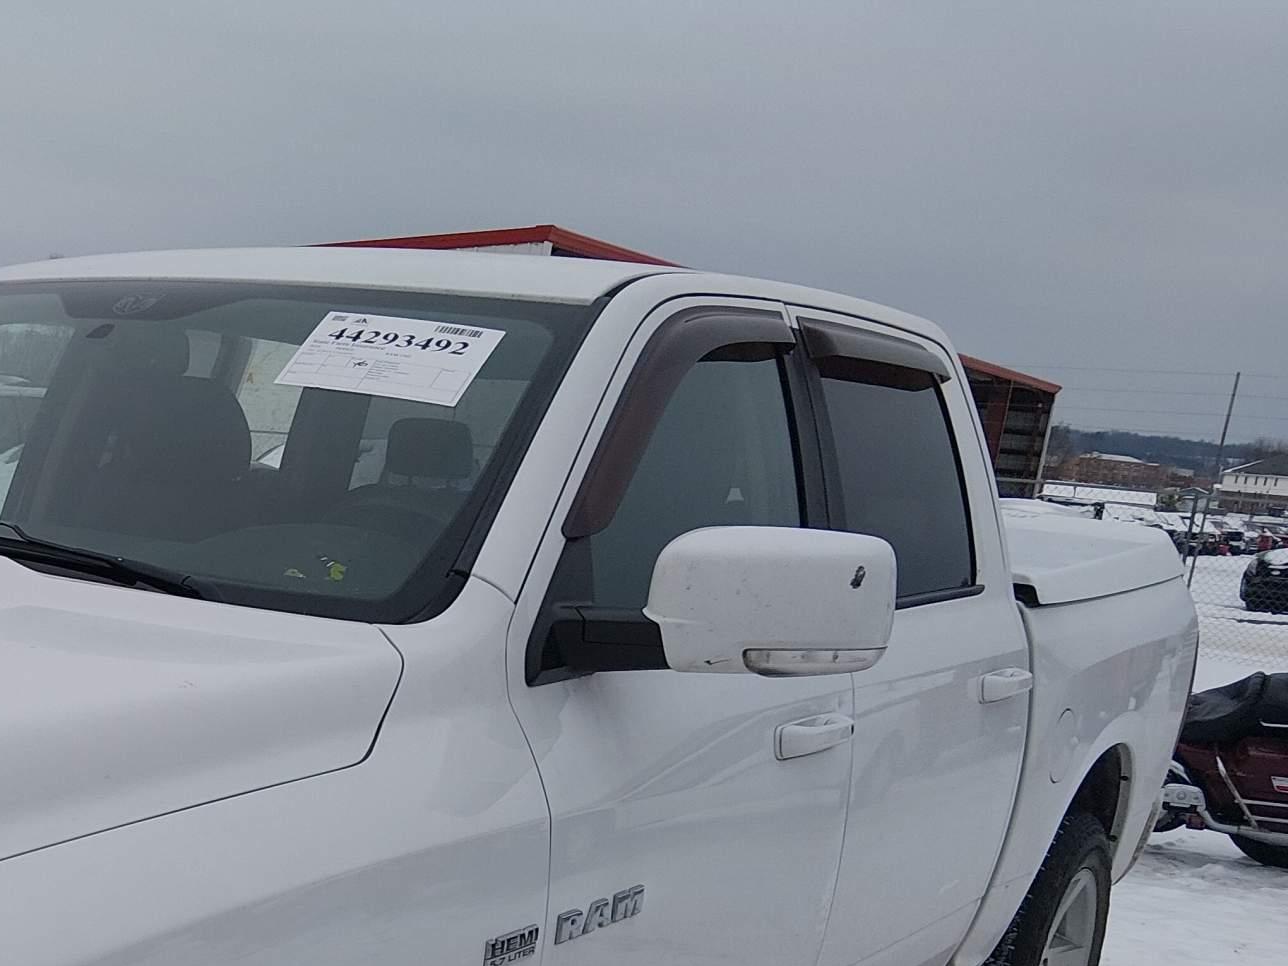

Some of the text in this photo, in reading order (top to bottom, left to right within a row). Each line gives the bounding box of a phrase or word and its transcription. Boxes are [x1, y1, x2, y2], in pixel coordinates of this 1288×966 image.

[329, 328, 470, 355] 44293492
[554, 884, 646, 946] RAM
[487, 924, 540, 957] HEMI
[508, 948, 535, 962] LITER
